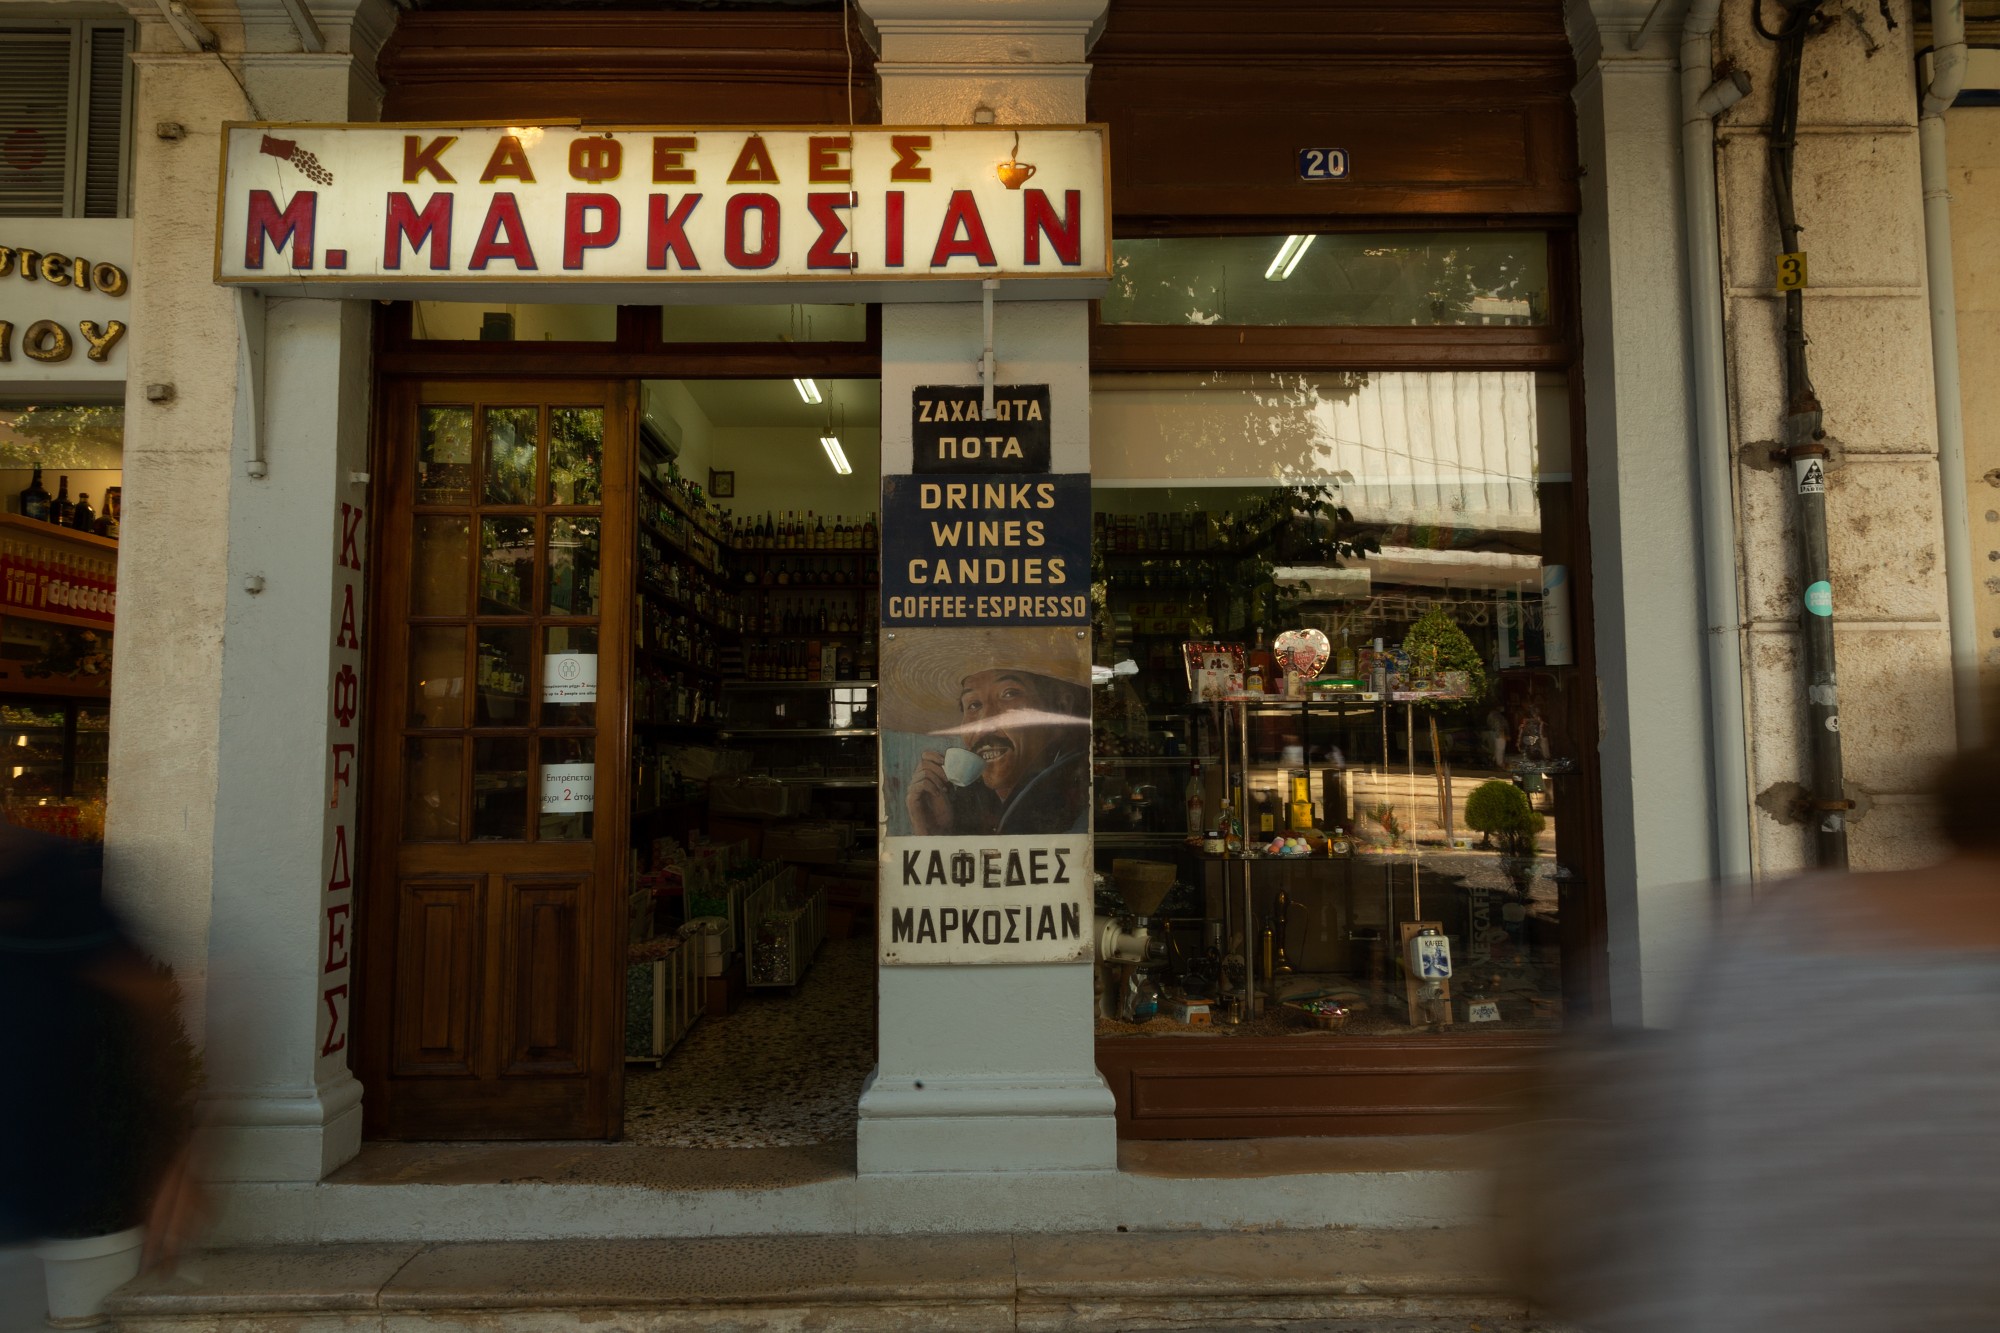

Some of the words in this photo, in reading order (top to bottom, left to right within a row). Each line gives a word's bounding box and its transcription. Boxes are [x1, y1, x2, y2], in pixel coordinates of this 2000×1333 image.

[404, 135, 931, 184] ΚΑΦΕΔΕΣ
[1306, 150, 1344, 176] 20
[245, 190, 347, 270] Μ.
[383, 189, 1081, 270] ΜΑΡΚΟΣΙΑΝ
[1783, 259, 1801, 285] 3
[919, 400, 1042, 422] ΖΑΧΑΩΤΑ
[939, 437, 1023, 458] ΠΟΤΑ
[920, 483, 1055, 509] DRINKS
[931, 521, 1045, 546] WINES
[908, 558, 1066, 584] CANDIES
[889, 596, 1086, 618] COFFEE-ESPRESSO
[546, 773, 592, 783] Επιτρέπεται
[563, 788, 571, 801] 2
[902, 848, 1071, 888] ΚΑΦΕΔΕΣ
[891, 902, 1081, 945] ΜΑΡΚΟΣΙΑΝ
